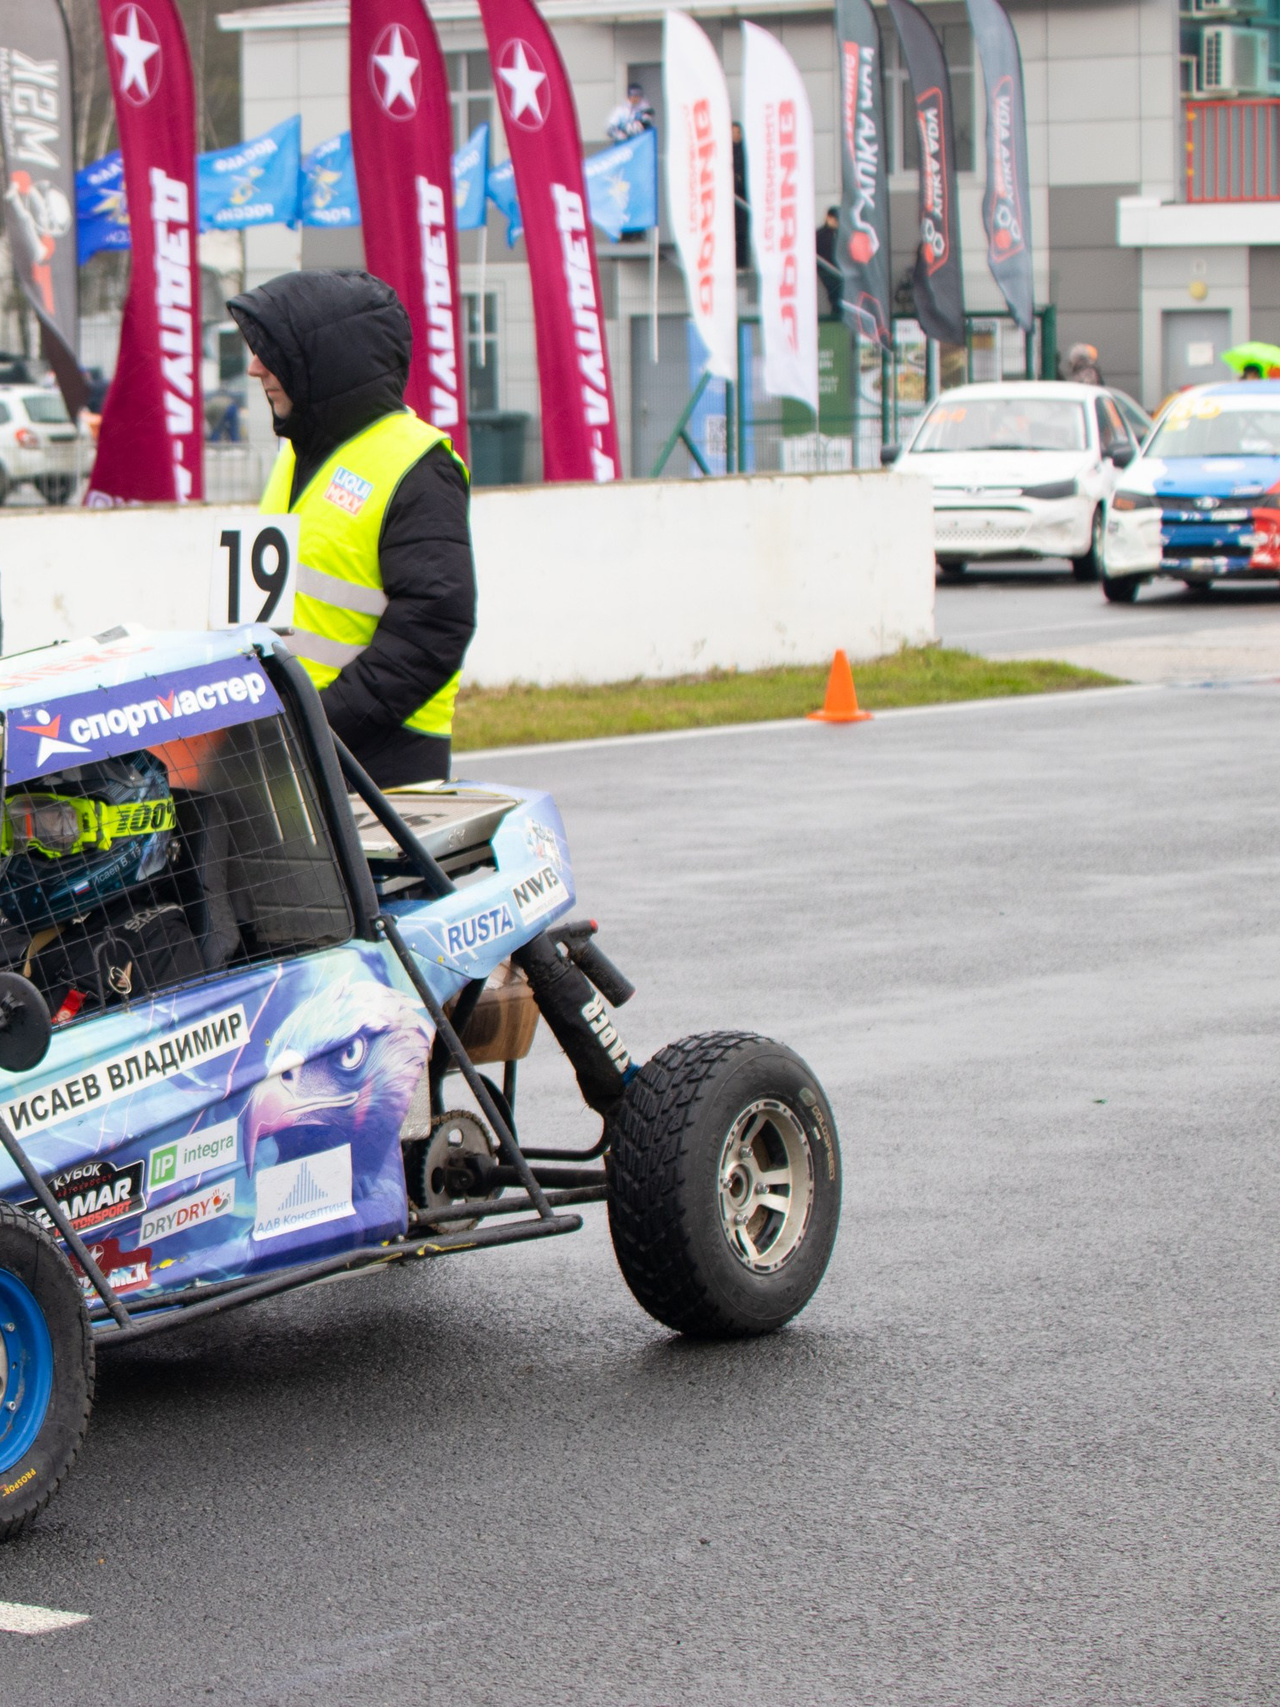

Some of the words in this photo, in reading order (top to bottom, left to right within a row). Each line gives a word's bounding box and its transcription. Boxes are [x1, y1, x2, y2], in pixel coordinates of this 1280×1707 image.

[325, 486, 365, 515] MOLY
[333, 467, 373, 499] LIQUI
[219, 525, 290, 624] 19
[69, 671, 267, 744] спортмастер
[512, 866, 561, 909] NWB
[447, 904, 514, 954] RUSTA
[9, 1072, 102, 1132] ИСАЕВ
[106, 1012, 243, 1092] ВЛАДИМИР
[53, 1163, 103, 1191] КУБОК
[154, 1154, 175, 1180] IP
[183, 1134, 234, 1165] integra
[141, 1196, 211, 1240] DRYDRY
[257, 1216, 282, 1234] АДВ
